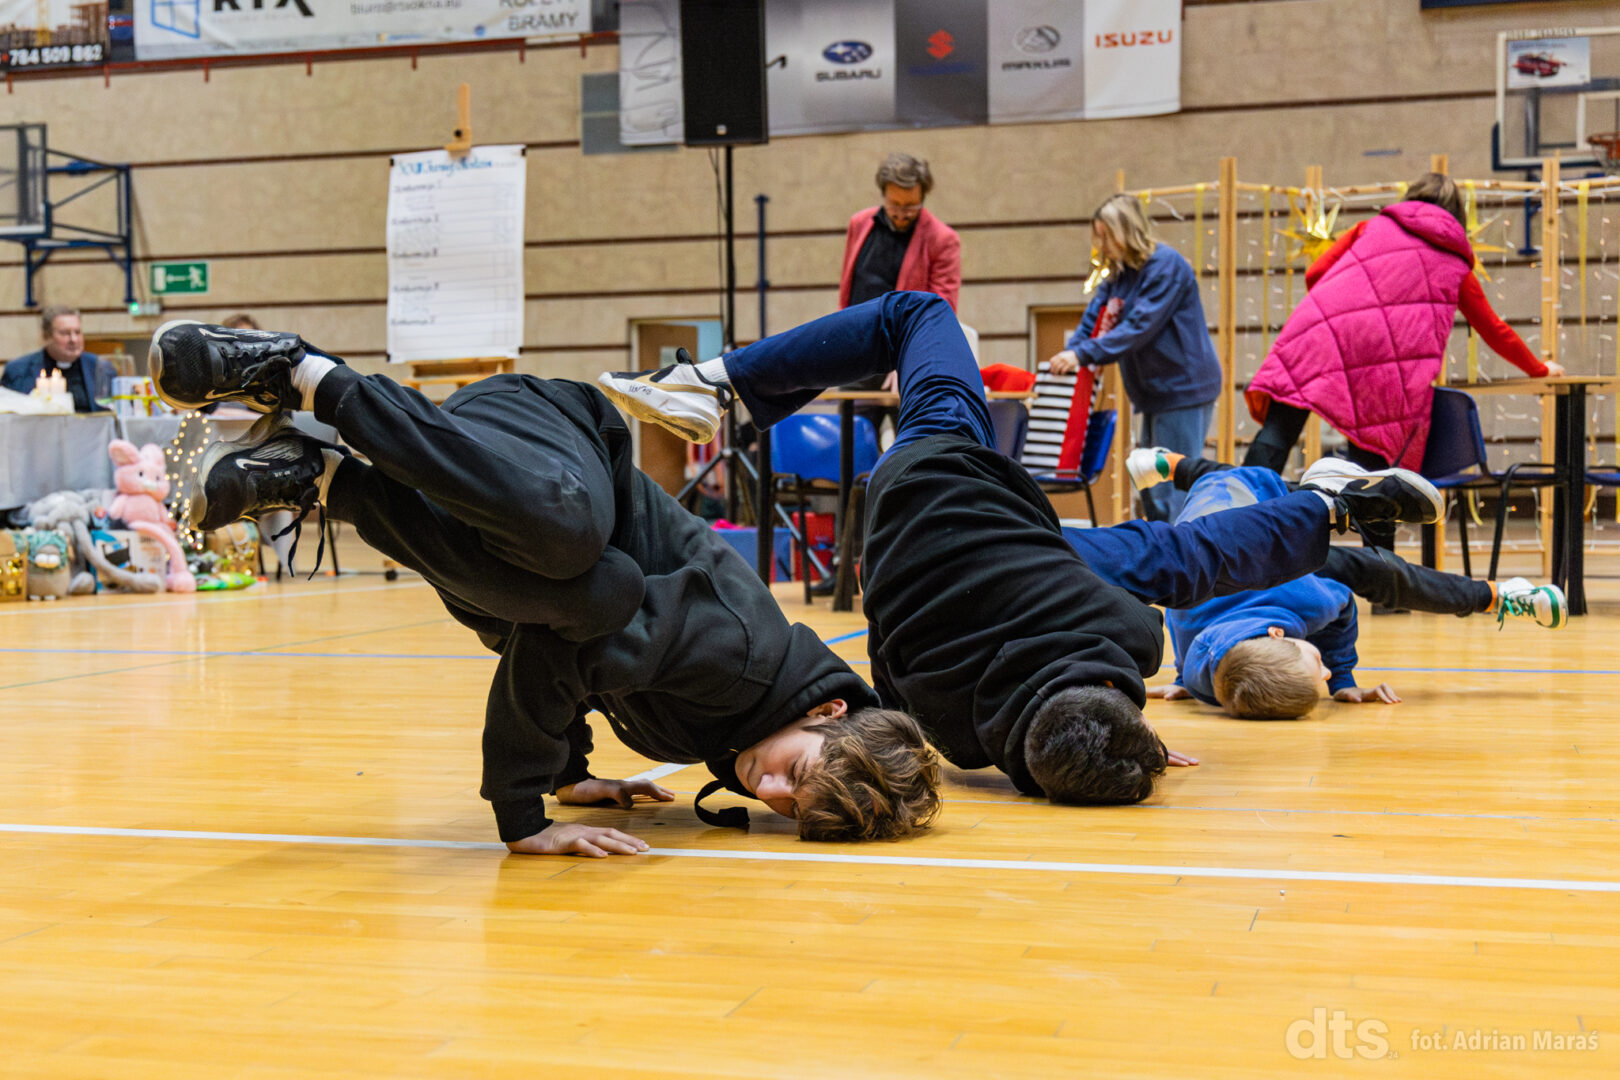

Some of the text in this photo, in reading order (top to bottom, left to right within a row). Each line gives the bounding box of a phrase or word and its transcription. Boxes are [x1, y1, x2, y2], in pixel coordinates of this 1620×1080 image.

[508, 11, 579, 31] BRAMY
[1095, 29, 1173, 48] ISUZU
[9, 48, 39, 66] 784
[815, 68, 881, 82] SUBARU
